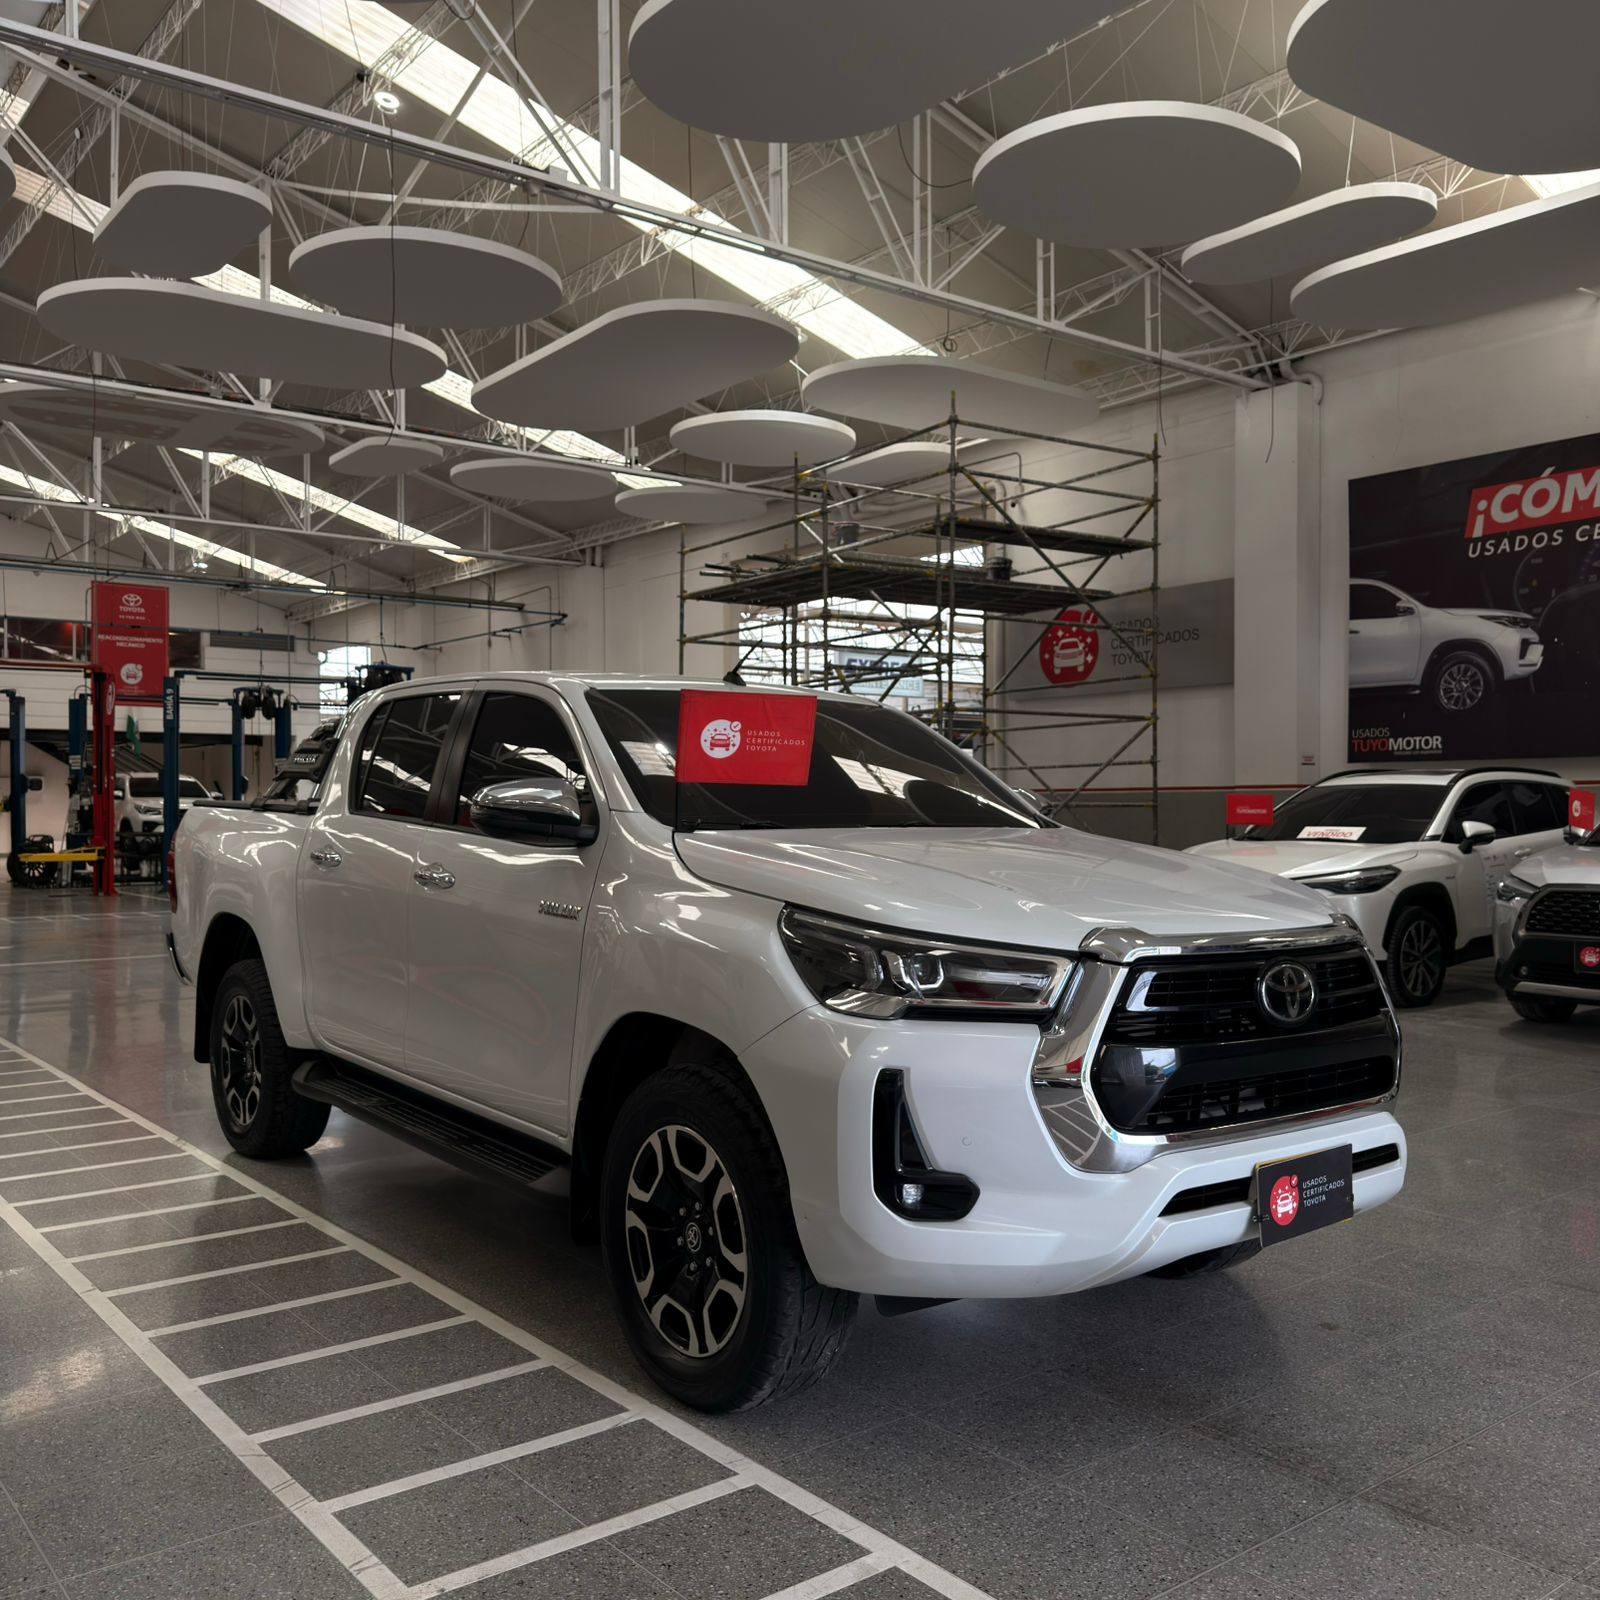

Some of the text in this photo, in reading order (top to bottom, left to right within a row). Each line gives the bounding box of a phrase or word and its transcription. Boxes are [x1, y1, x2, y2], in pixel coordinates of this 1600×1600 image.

[1472, 466, 1600, 538] ¡CÓM
[1468, 529, 1563, 558] USADOS
[1111, 628, 1200, 650] CERTIFCADOS
[747, 730, 781, 738] USADOS
[1352, 727, 1390, 739] USADOS
[746, 737, 806, 747] CERTIFICADOS
[1352, 735, 1443, 753] TUYOMOTOR
[1306, 830, 1353, 838] VENDIDO
[1303, 1175, 1327, 1188] USADOS
[1302, 1179, 1345, 1198] CERTIFICADOS
[1303, 1196, 1326, 1207] TOYOTA
